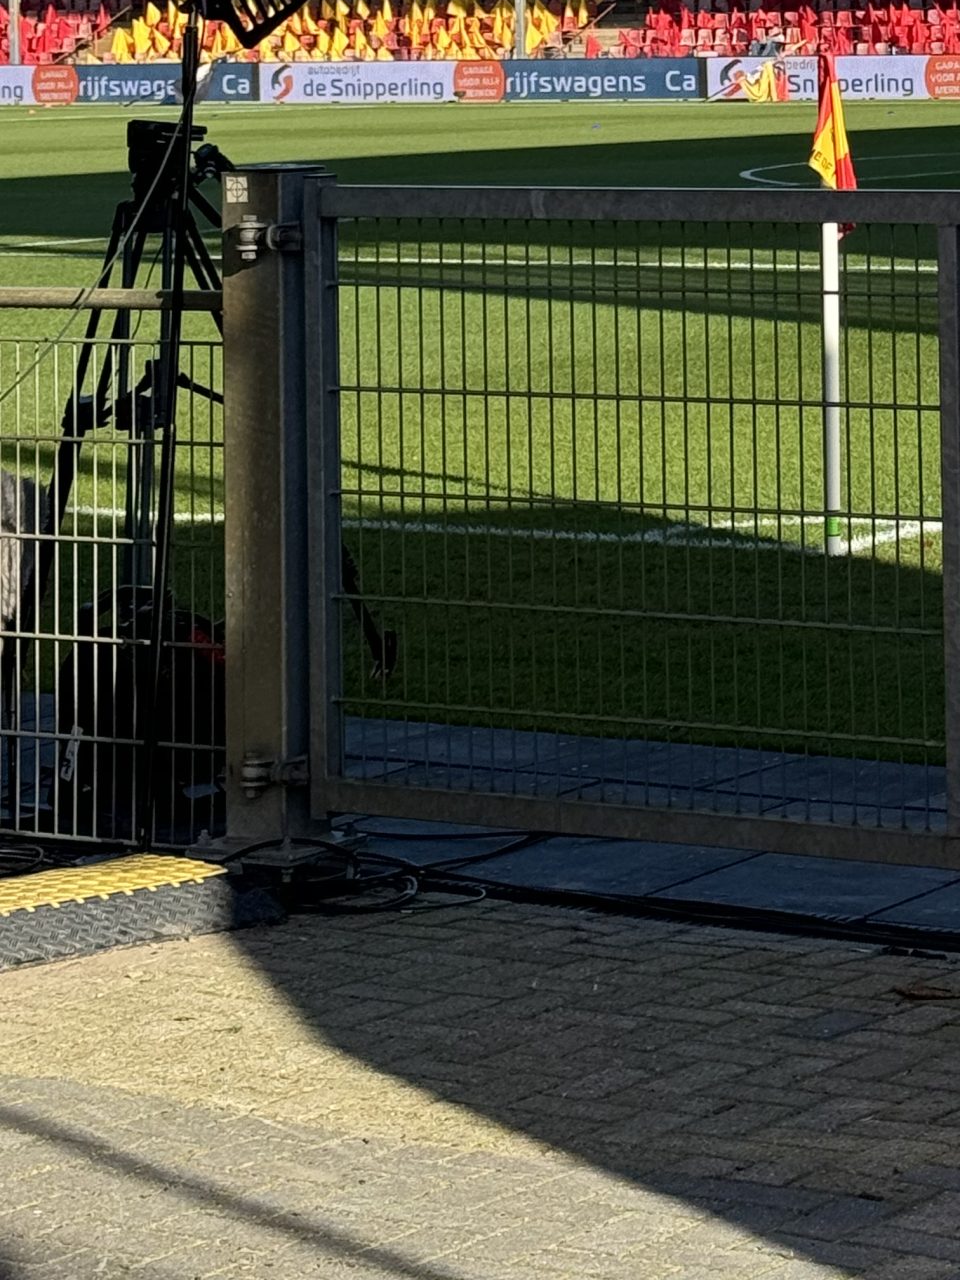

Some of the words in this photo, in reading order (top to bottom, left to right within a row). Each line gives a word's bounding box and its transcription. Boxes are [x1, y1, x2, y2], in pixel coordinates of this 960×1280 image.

[222, 74, 250, 95] Ca
[303, 79, 327, 97] de
[331, 78, 445, 100] Snipperling
[506, 71, 646, 97] rijfswagens
[665, 70, 696, 92] Ca
